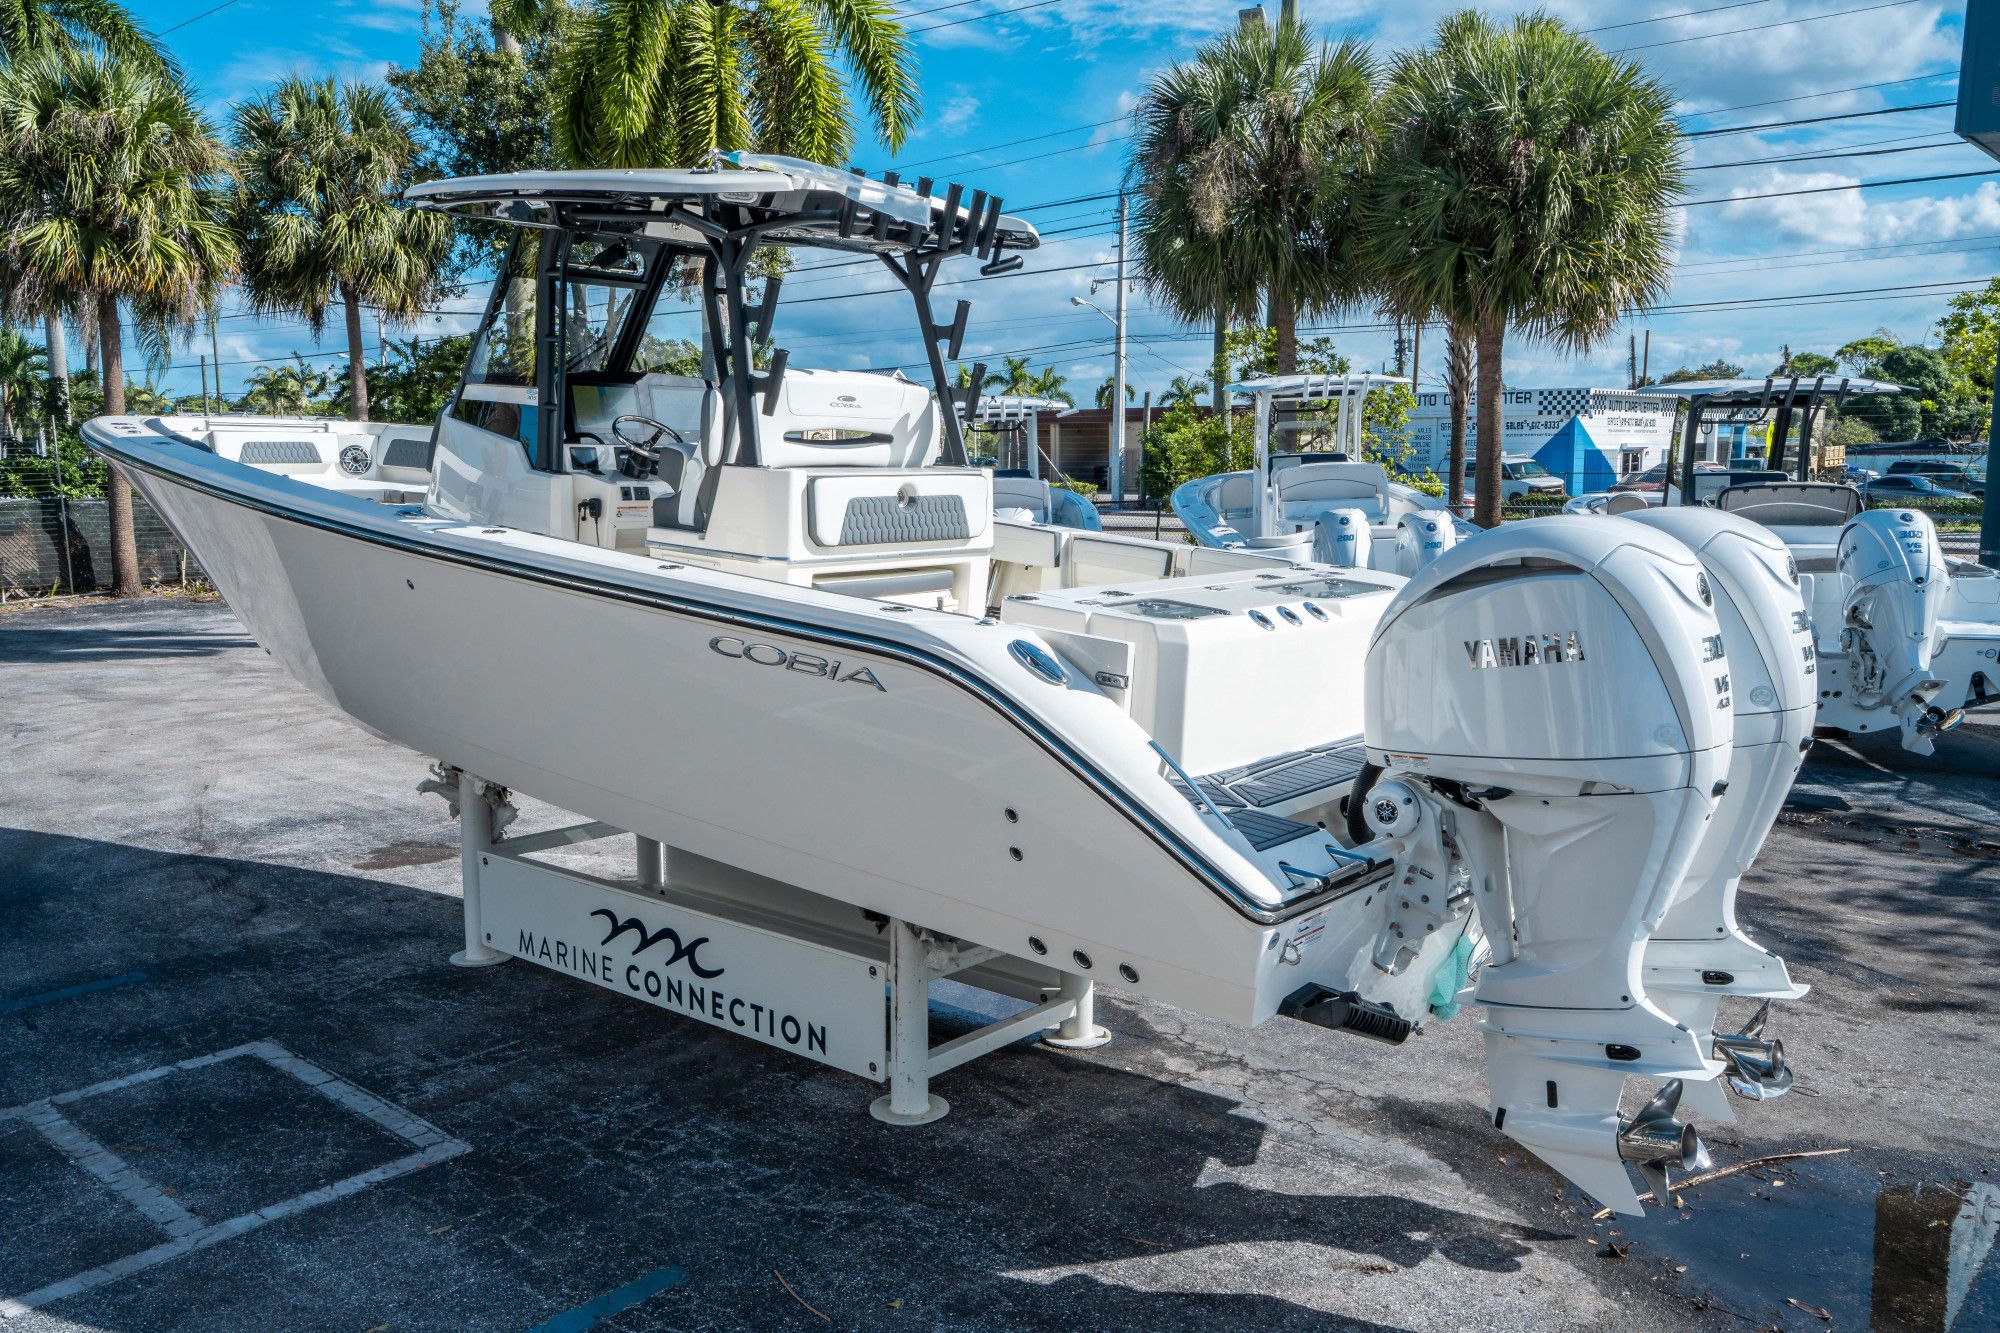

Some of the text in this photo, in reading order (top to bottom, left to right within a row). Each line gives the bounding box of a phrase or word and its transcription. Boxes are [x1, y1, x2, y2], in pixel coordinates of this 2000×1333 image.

[1609, 400, 1623, 412] AUTO
[1336, 534, 1355, 542] 200
[1423, 541, 1441, 549] 200
[1463, 631, 1586, 670] YAMAHA
[708, 636, 888, 693] COBIA
[518, 928, 827, 1057] MARINE CONNECTION
